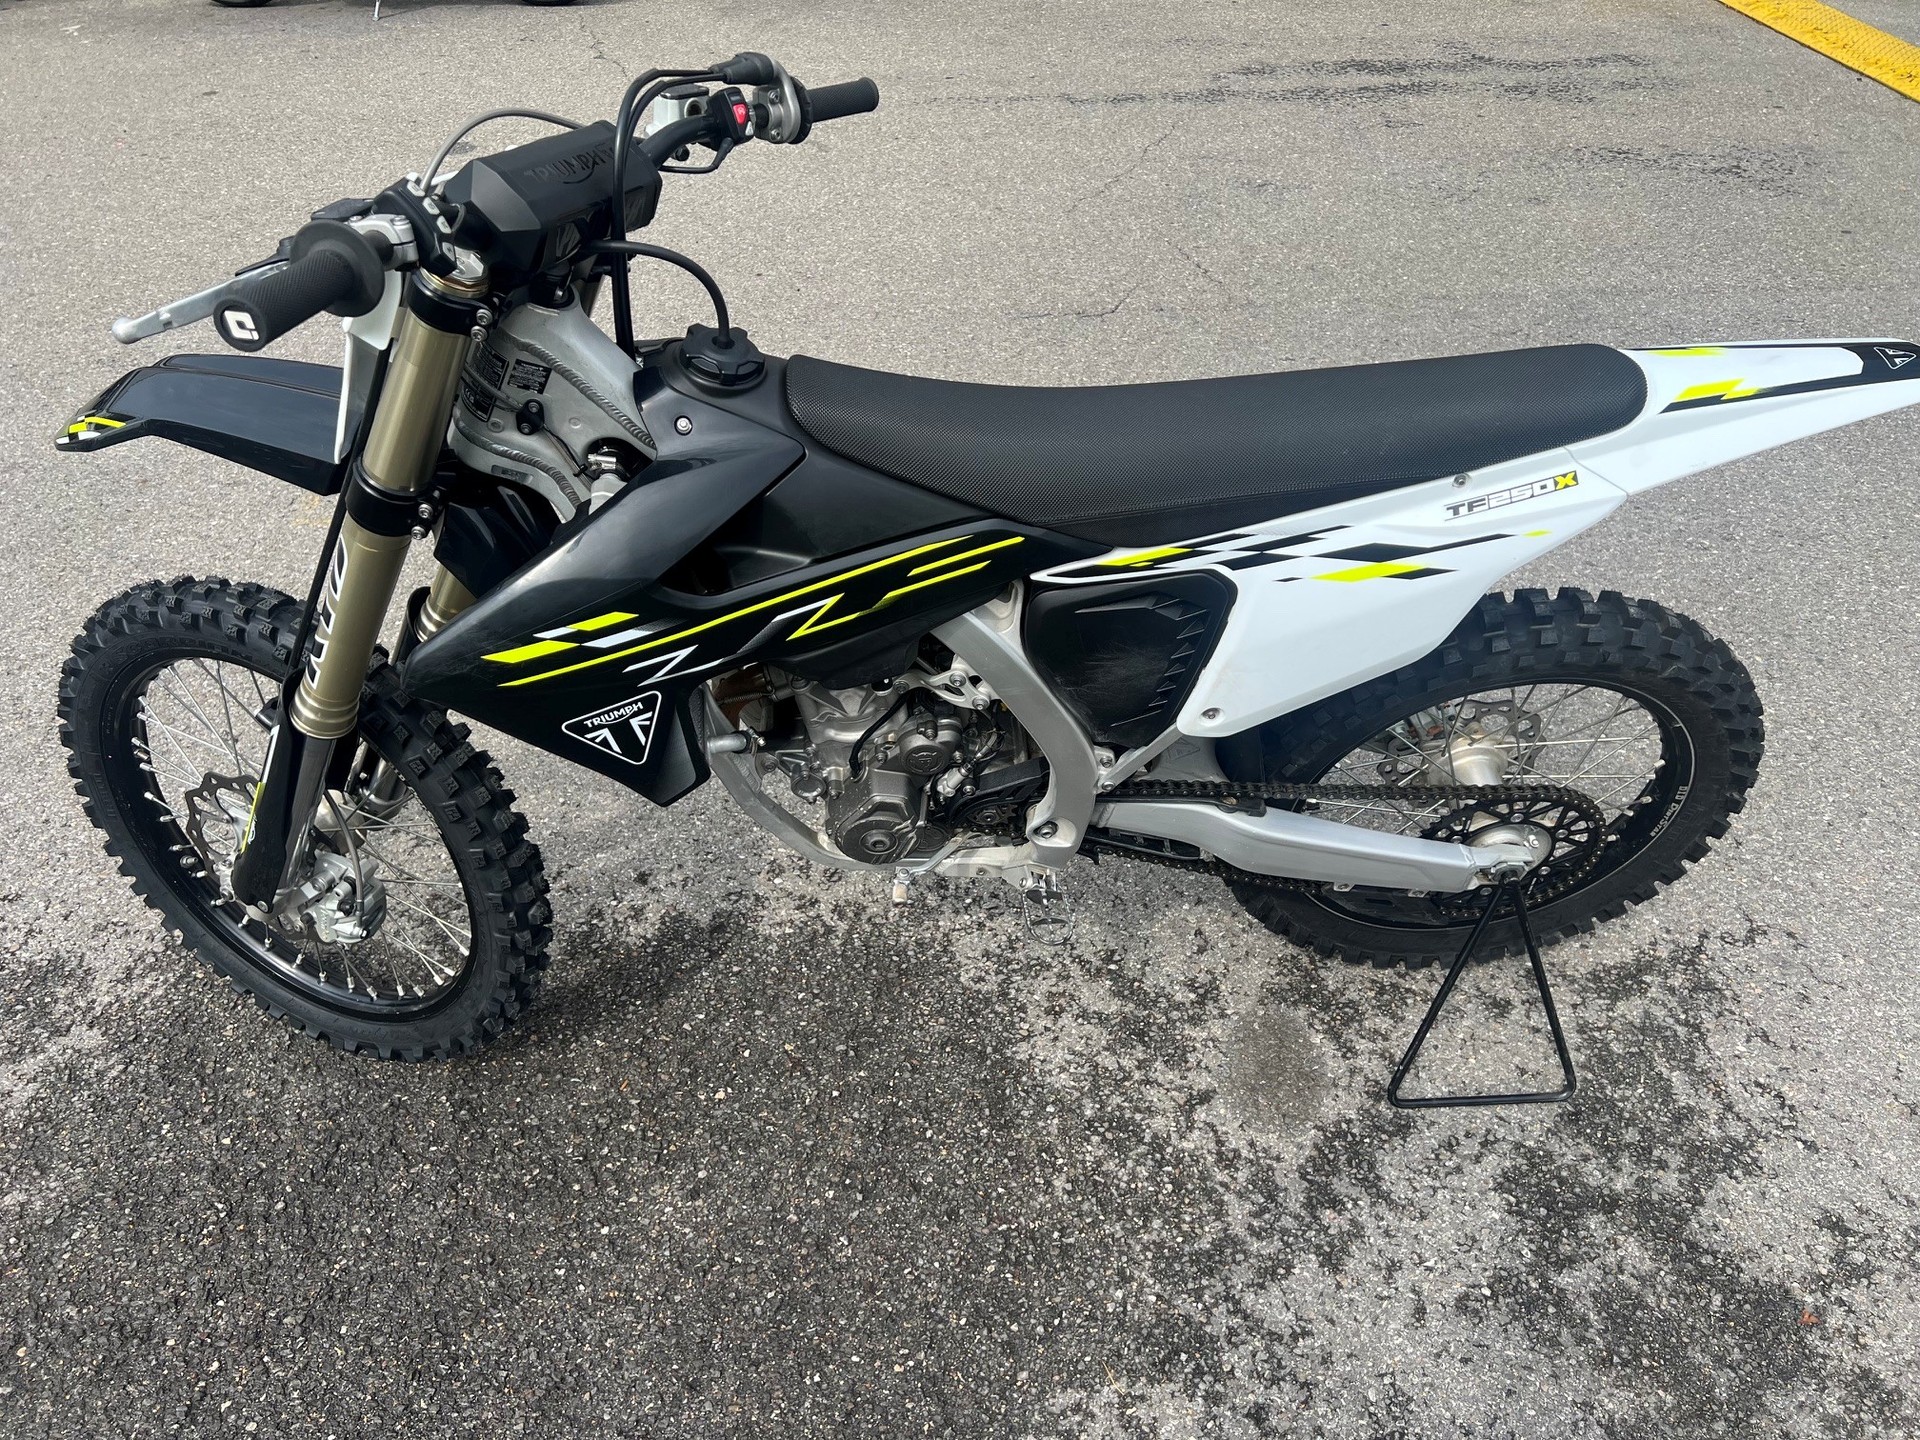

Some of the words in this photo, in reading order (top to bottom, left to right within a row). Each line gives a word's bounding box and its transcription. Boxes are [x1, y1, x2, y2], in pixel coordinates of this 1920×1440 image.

[524, 149, 606, 184] TRIUMPH
[1446, 470, 1578, 516] TF250X
[583, 702, 644, 728] TRIUMPH
[1674, 785, 1689, 801] DID
